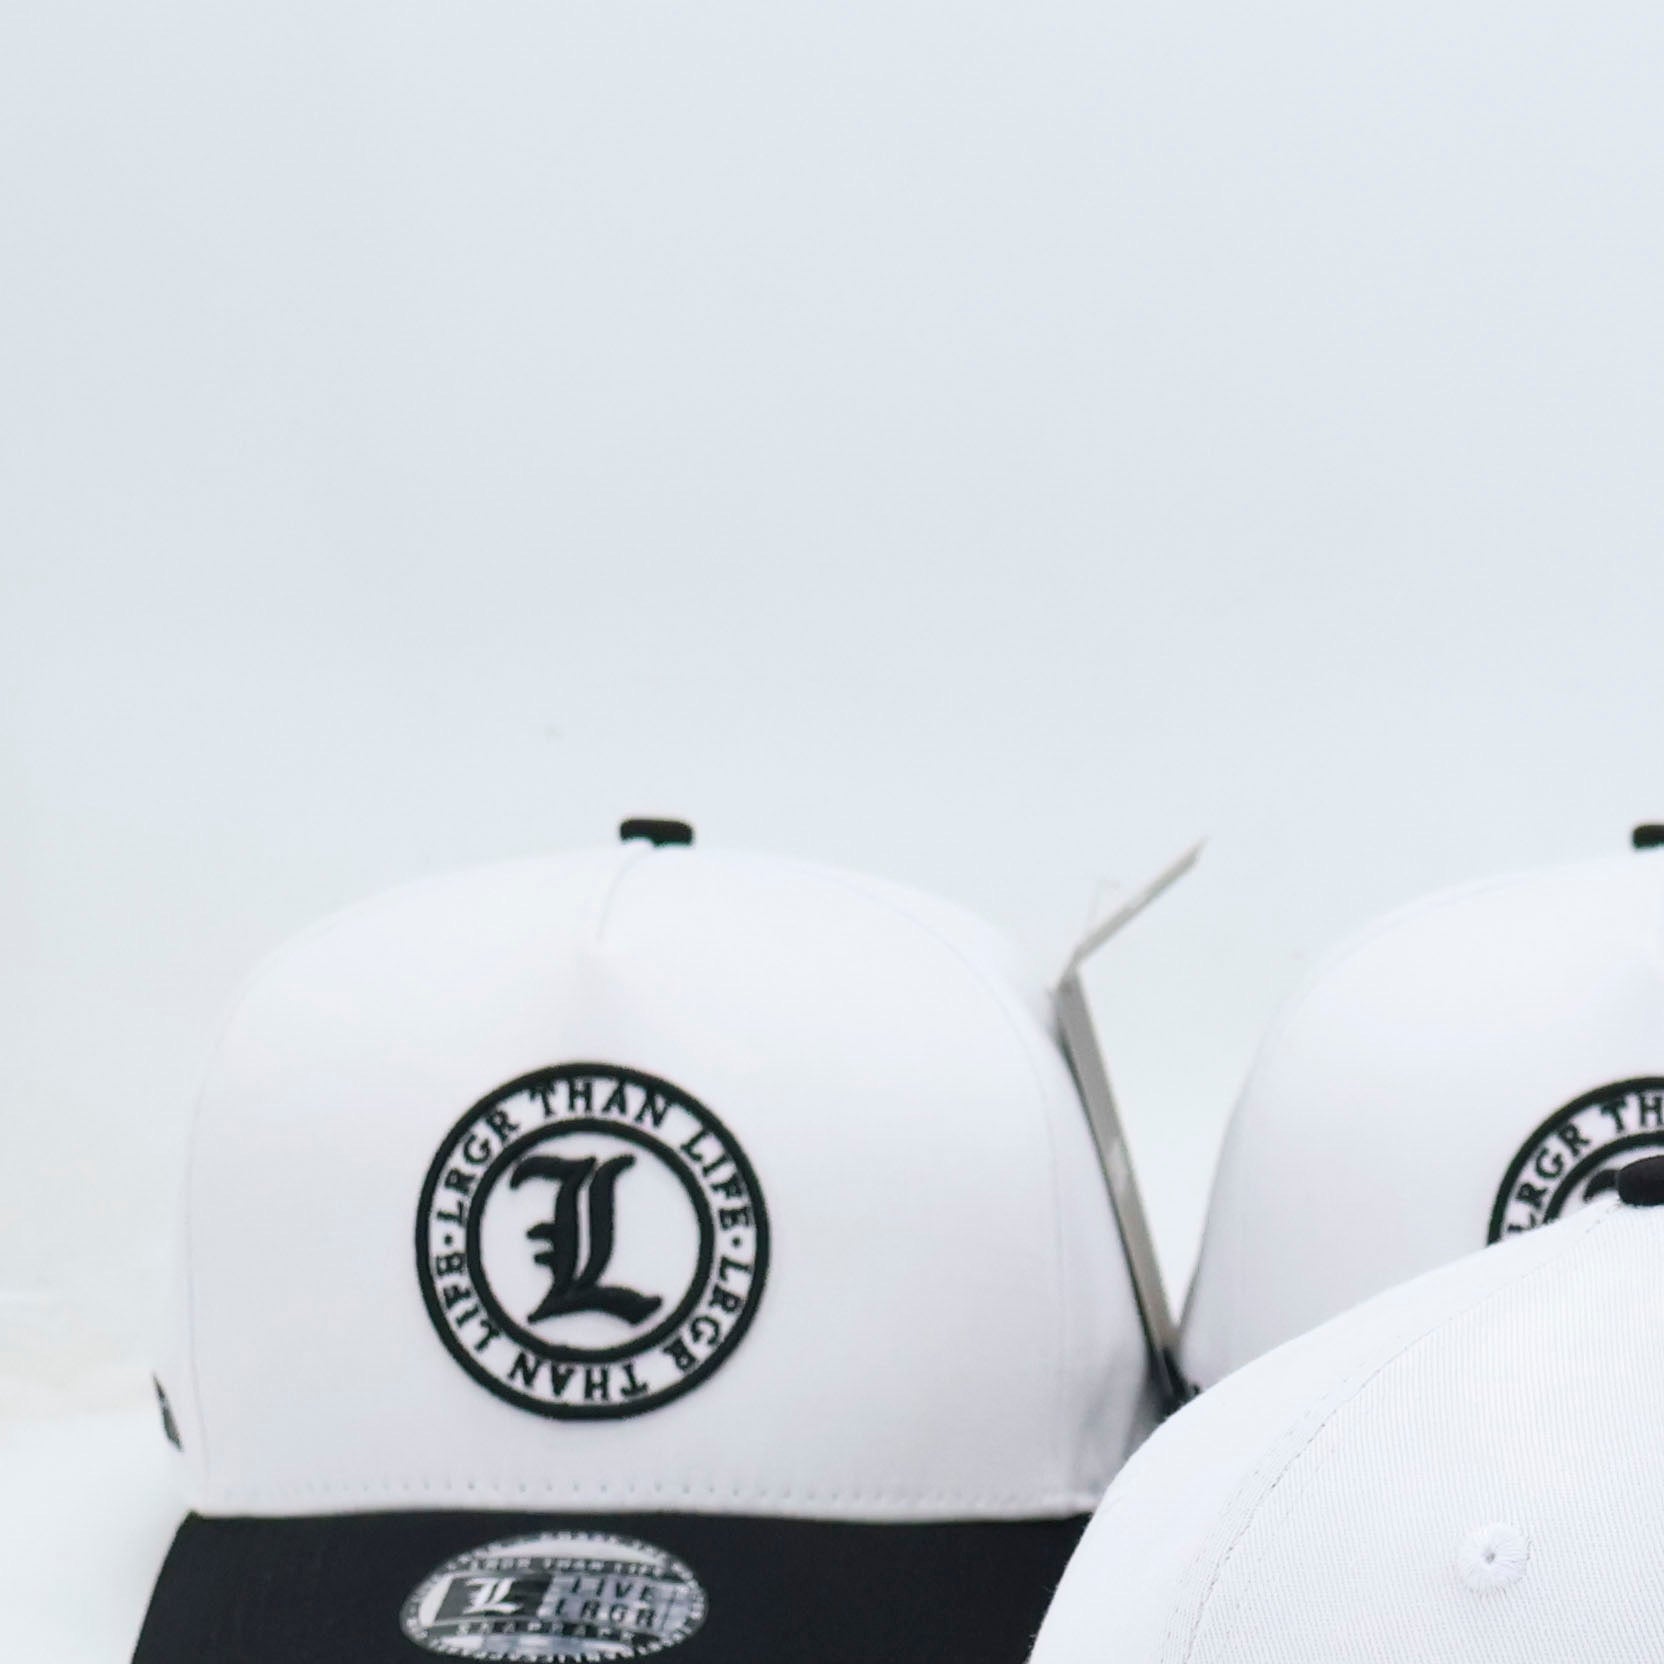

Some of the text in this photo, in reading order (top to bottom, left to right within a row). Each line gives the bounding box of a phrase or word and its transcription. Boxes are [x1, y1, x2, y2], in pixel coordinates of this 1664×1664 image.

[437, 1081, 751, 1230] LRGR THAN LIFE
[436, 1254, 750, 1400] LRGR THAN LIFE
